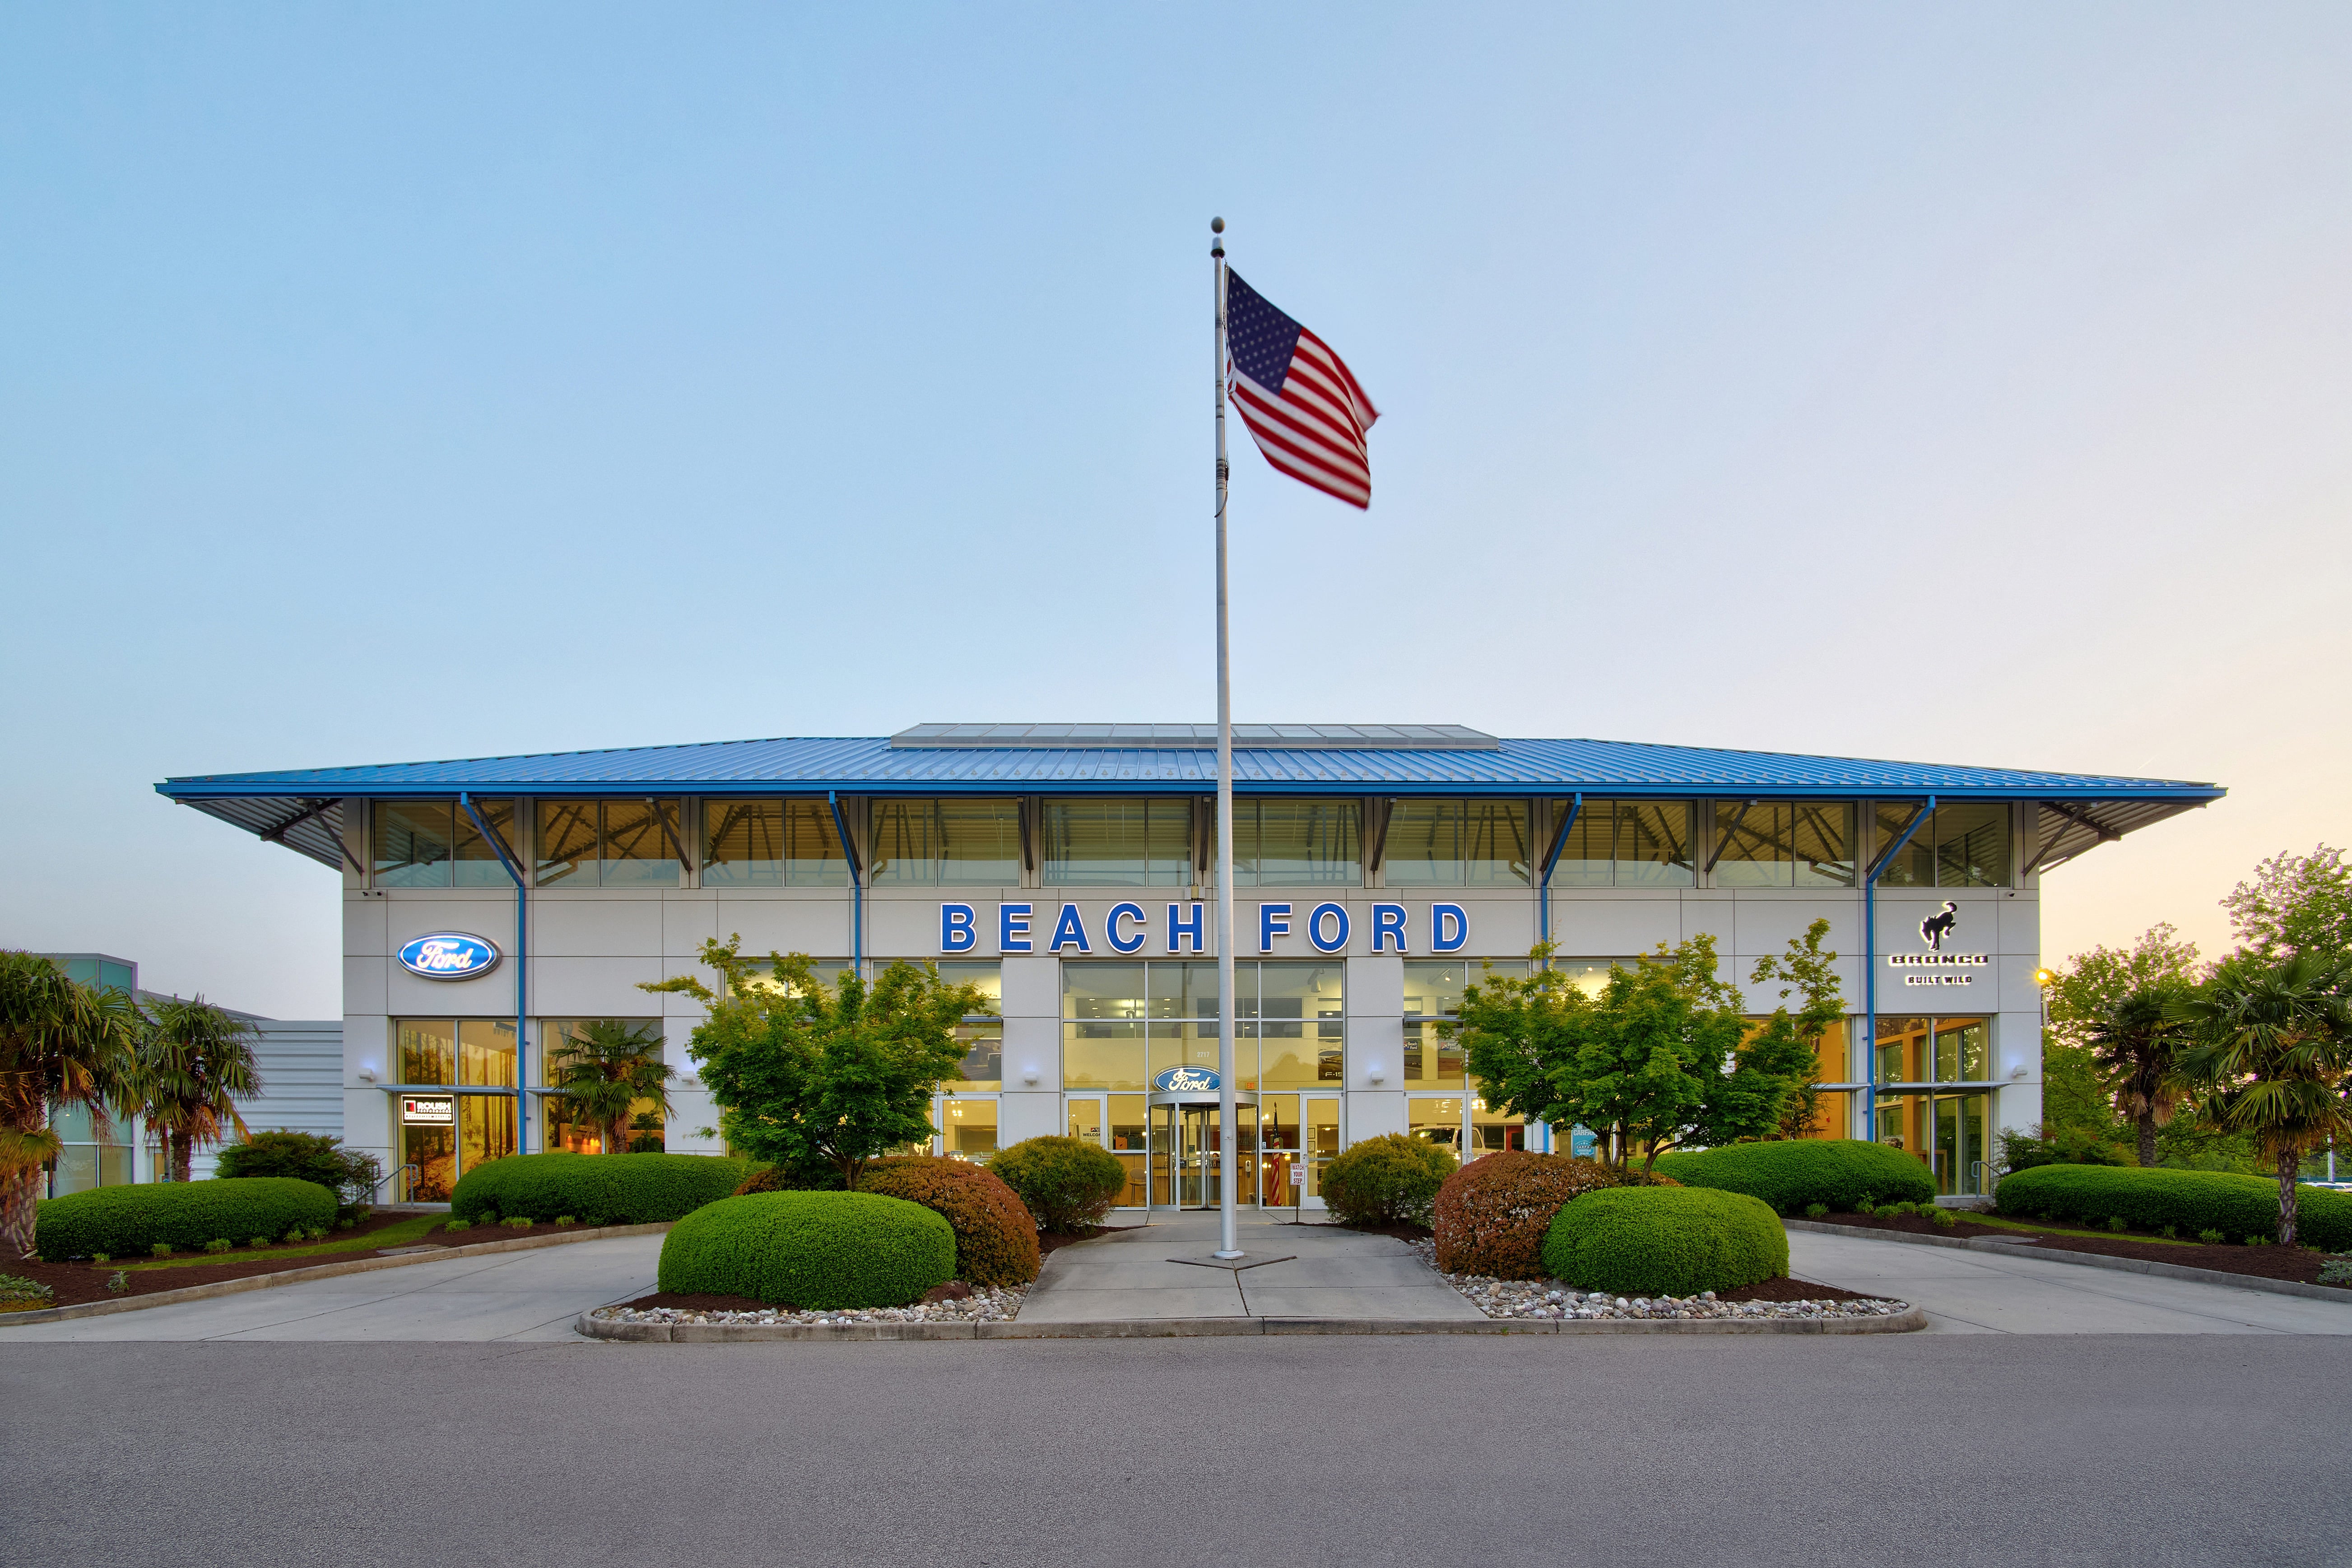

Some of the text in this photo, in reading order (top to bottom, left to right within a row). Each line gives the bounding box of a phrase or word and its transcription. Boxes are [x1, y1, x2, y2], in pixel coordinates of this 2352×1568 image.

[940, 902, 1469, 954] BEACH FORD
[416, 941, 474, 968] Ford
[1891, 955, 1988, 964] BRONCO
[1168, 1072, 1211, 1091] Ford
[417, 1102, 451, 1110] ROUSH
